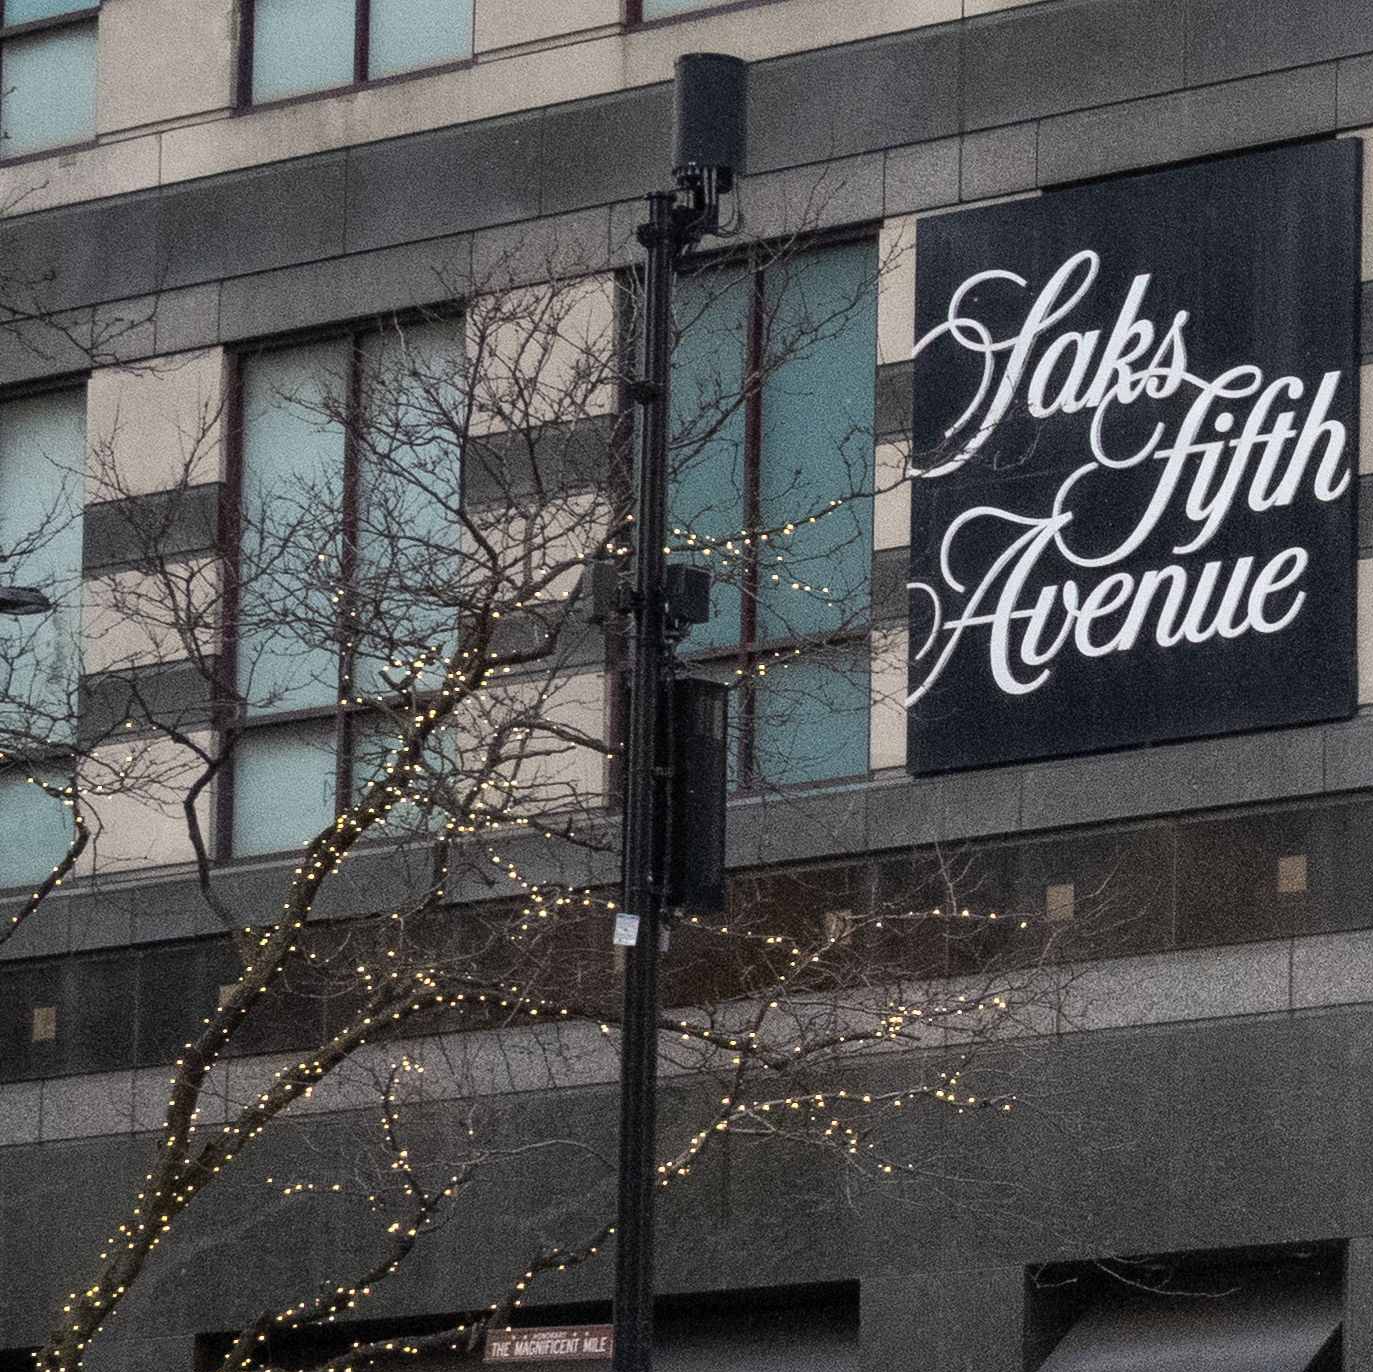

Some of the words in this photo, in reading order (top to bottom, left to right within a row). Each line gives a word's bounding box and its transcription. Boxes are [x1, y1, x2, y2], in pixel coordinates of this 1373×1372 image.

[908, 250, 1190, 478] Saks
[1053, 364, 1352, 568] Fifth
[906, 506, 1310, 707] Avenue
[491, 1341, 511, 1357] THE
[514, 1338, 580, 1356] MAGNIFICENT
[582, 1336, 607, 1353] MILE
